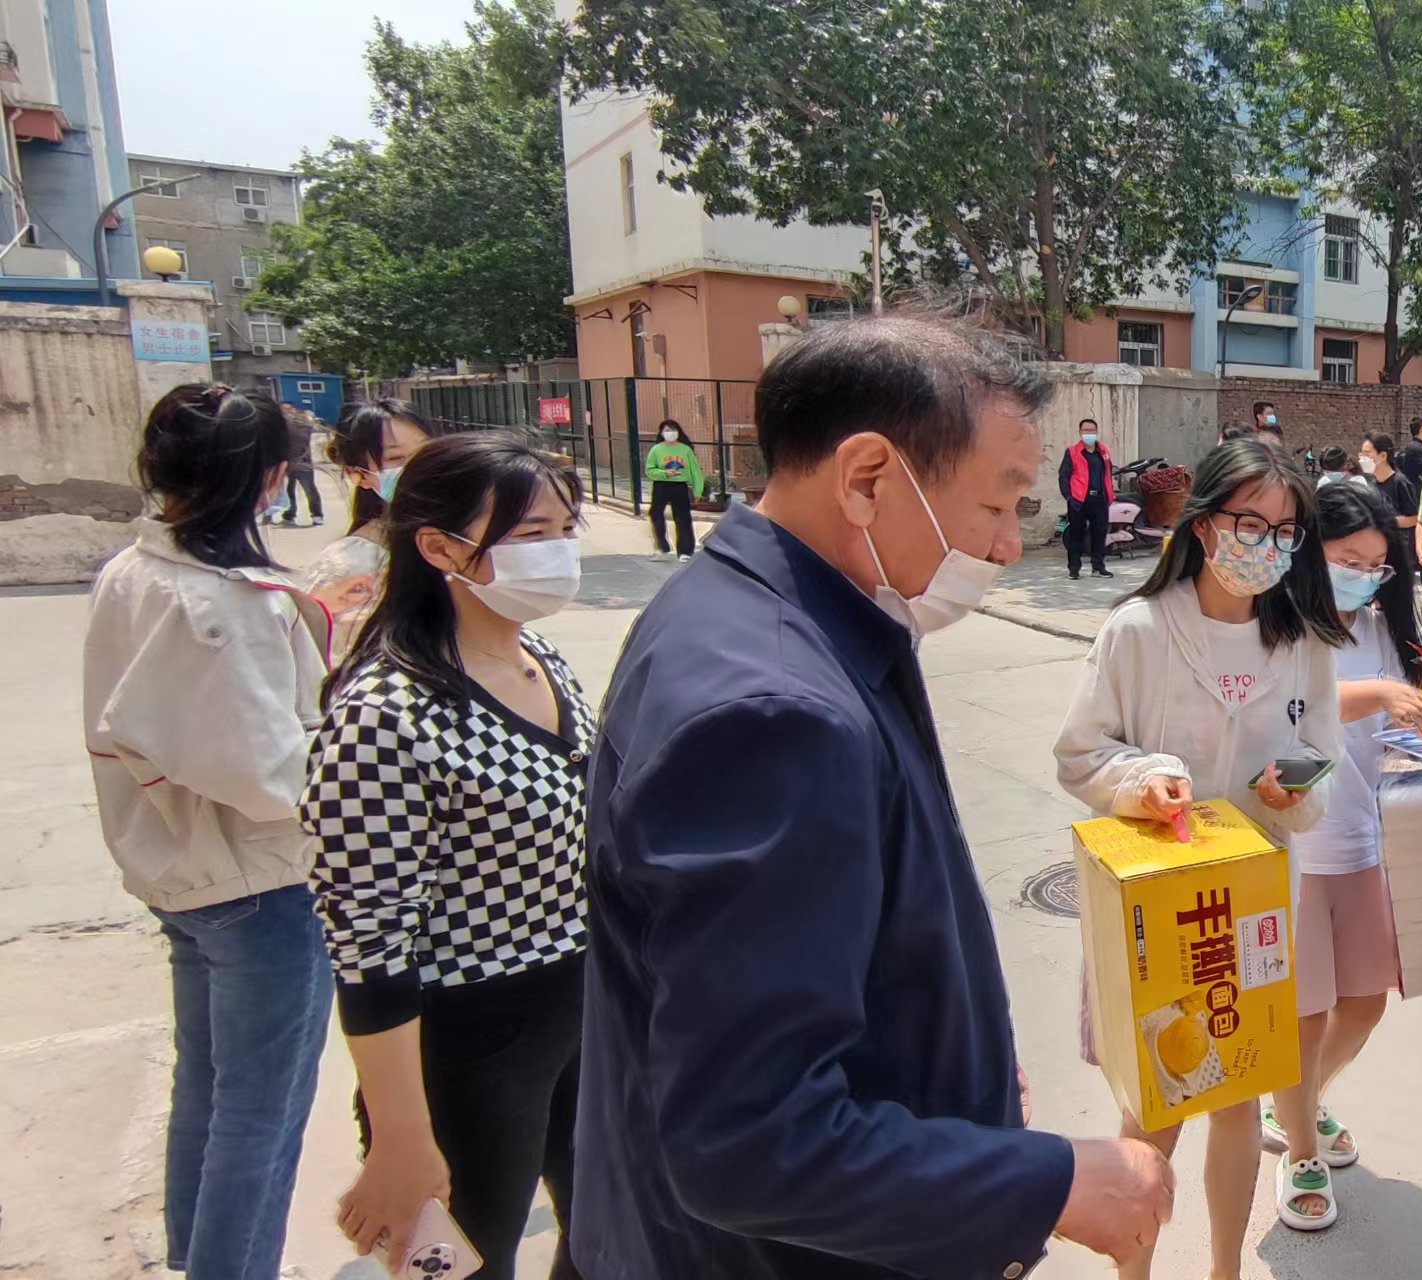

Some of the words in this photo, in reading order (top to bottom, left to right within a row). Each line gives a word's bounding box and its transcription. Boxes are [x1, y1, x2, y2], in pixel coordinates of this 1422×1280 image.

[139, 326, 201, 340] 女生宿舍
[142, 342, 201, 356] 男士止步
[1176, 887, 1239, 1038] 手撕面包
